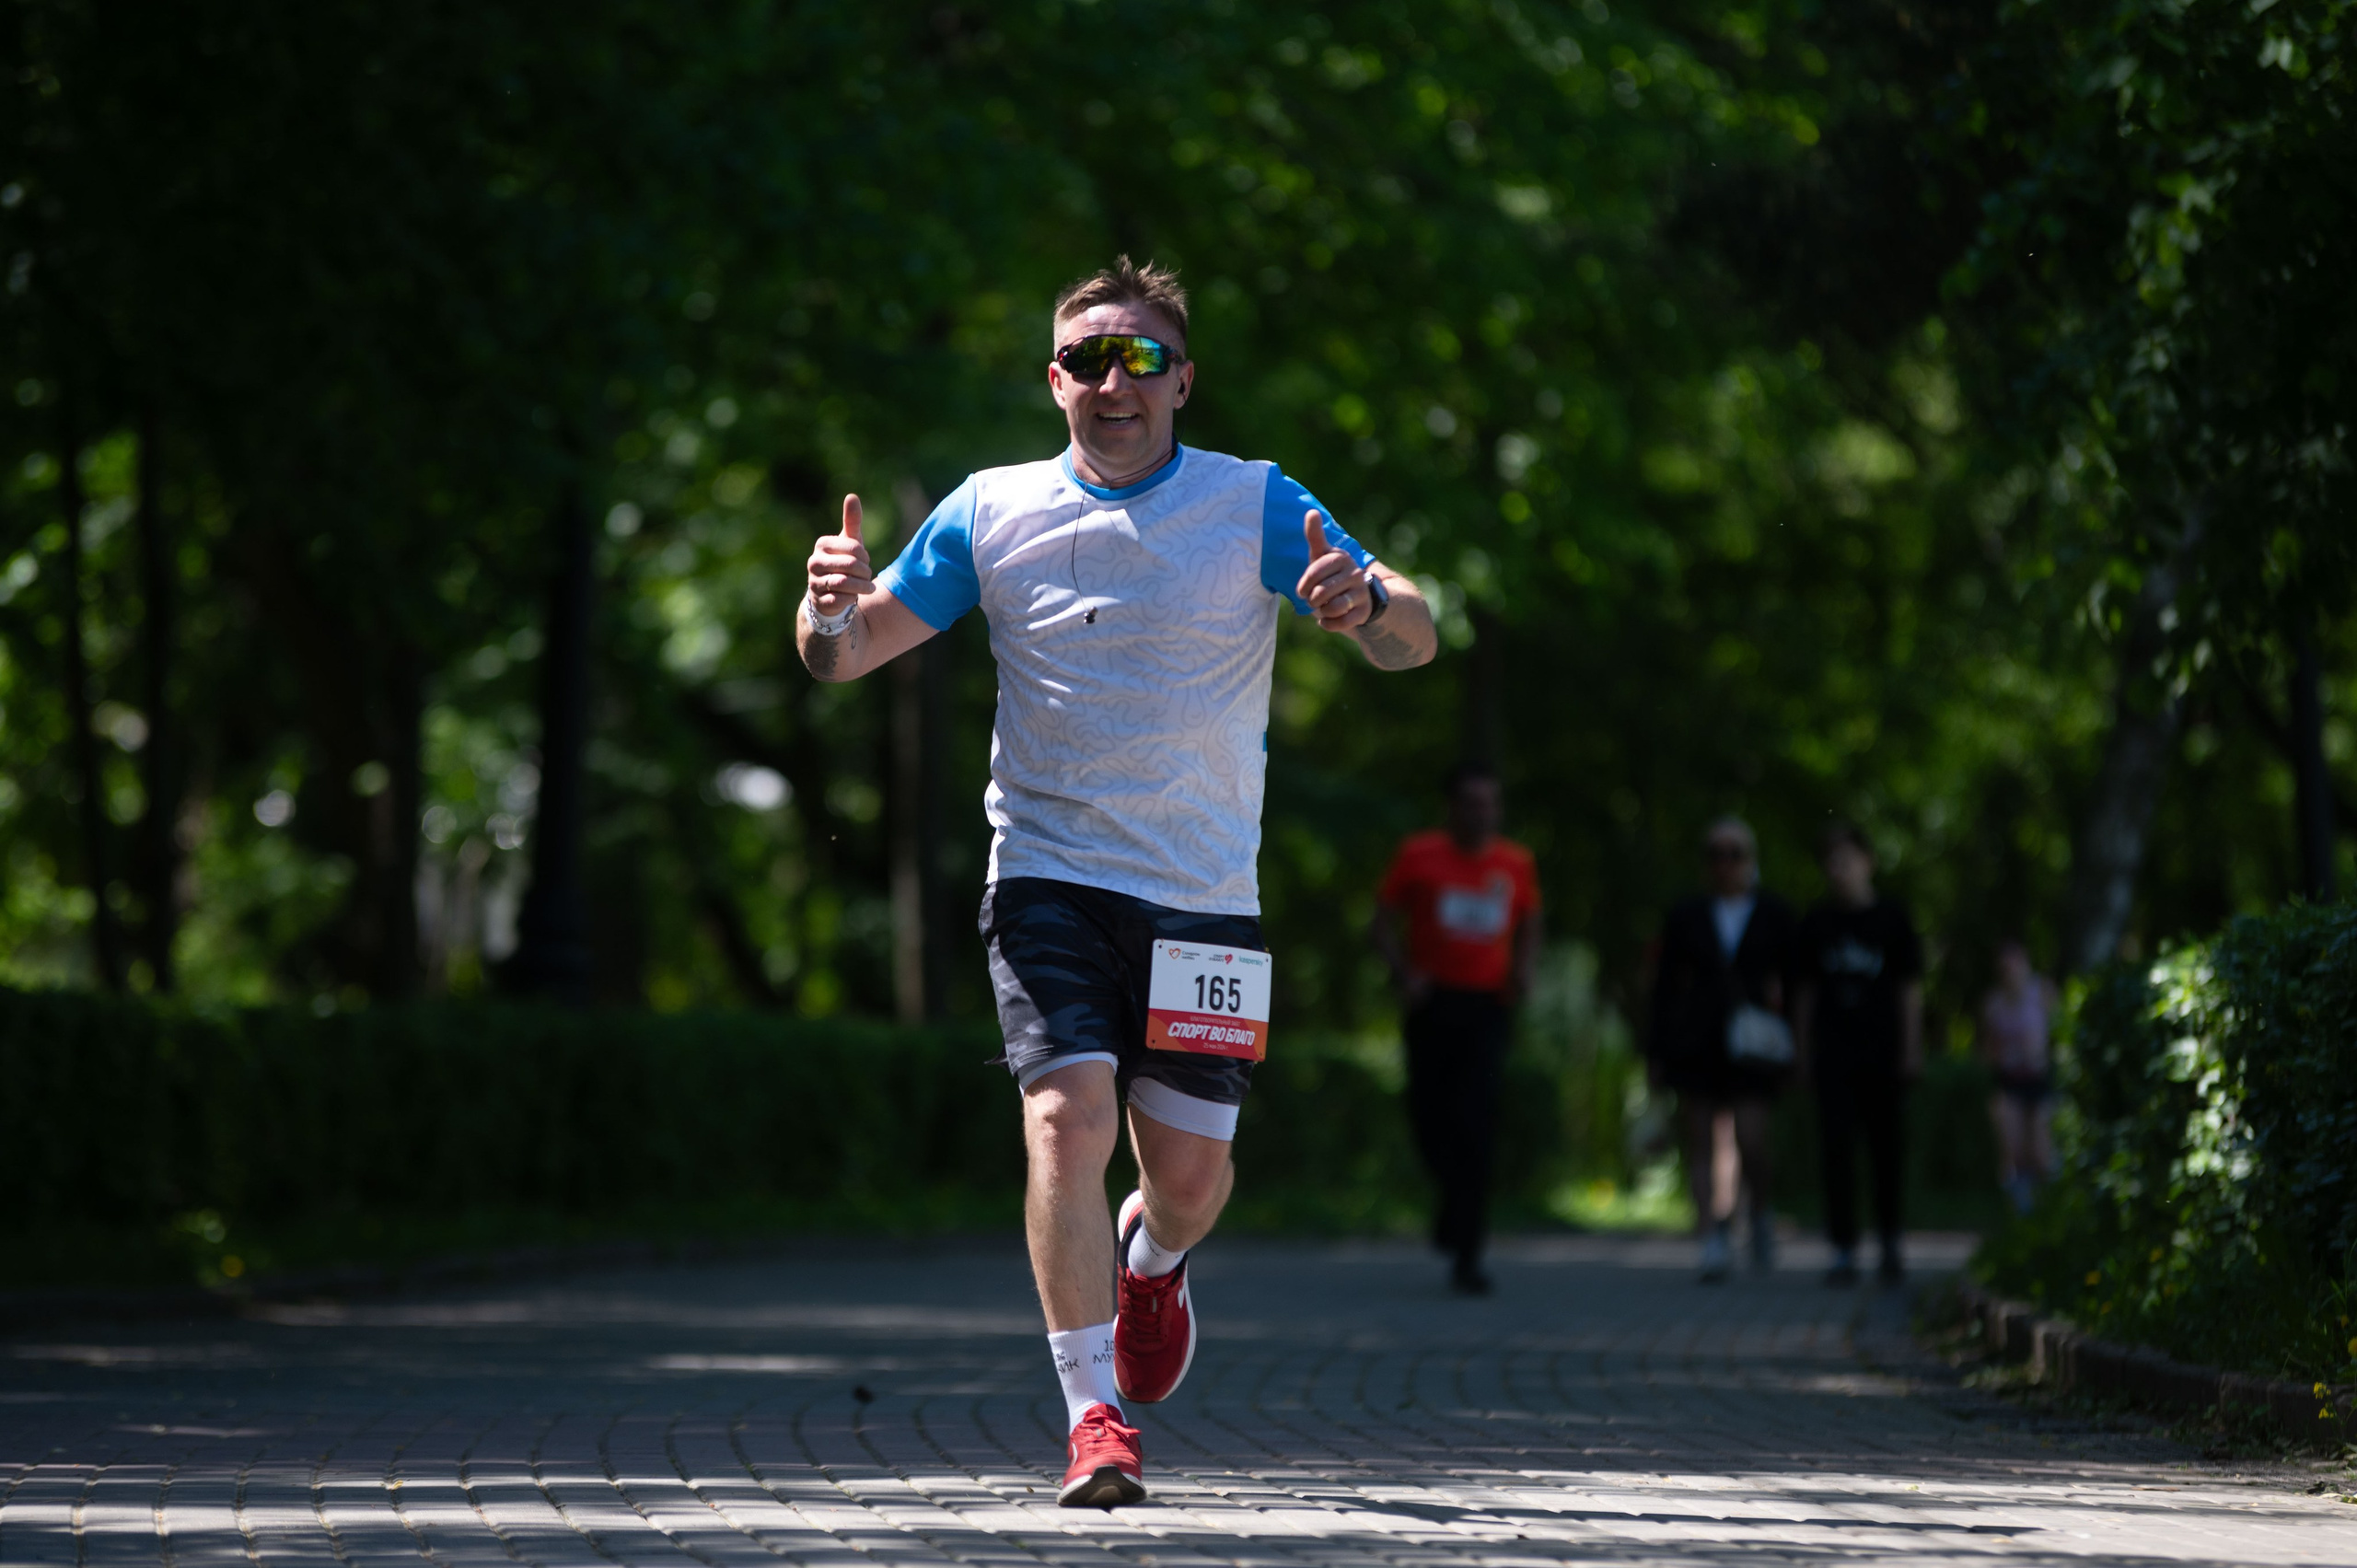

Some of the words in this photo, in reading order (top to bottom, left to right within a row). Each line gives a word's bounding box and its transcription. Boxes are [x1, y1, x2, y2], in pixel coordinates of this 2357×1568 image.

[1238, 956, 1263, 968] kaspersky
[1195, 974, 1241, 1013] 165
[1167, 1021, 1211, 1040] СПОРТ
[1209, 1026, 1226, 1041] ВО
[1225, 1028, 1256, 1046] БЛАГО
